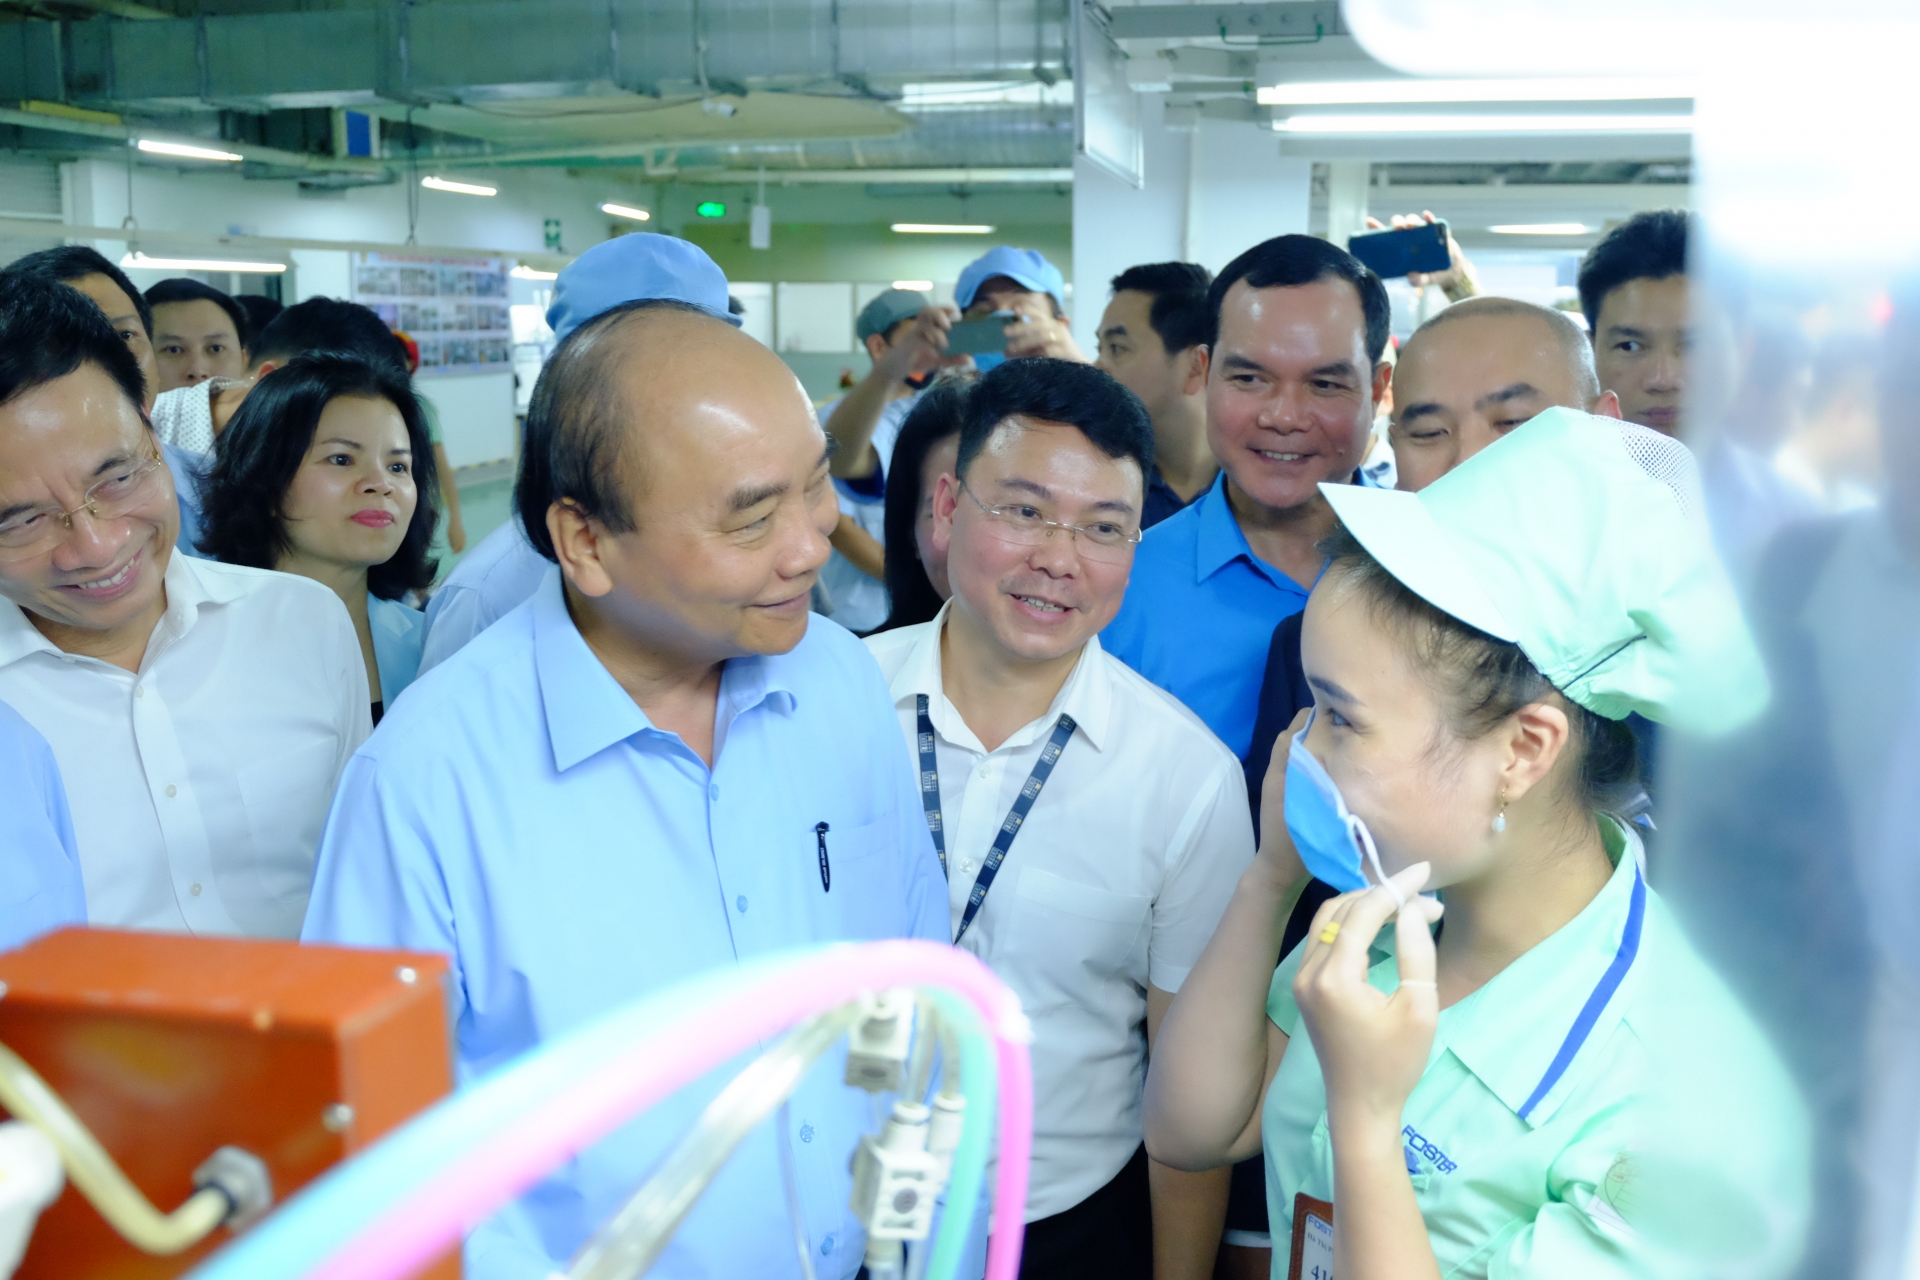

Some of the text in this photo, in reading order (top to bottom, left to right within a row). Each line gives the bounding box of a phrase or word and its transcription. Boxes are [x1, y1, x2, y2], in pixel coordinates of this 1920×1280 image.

[1402, 1124, 1458, 1175] FOSTER
[1308, 1215, 1333, 1237] FOST
[1310, 1264, 1333, 1280] 41
